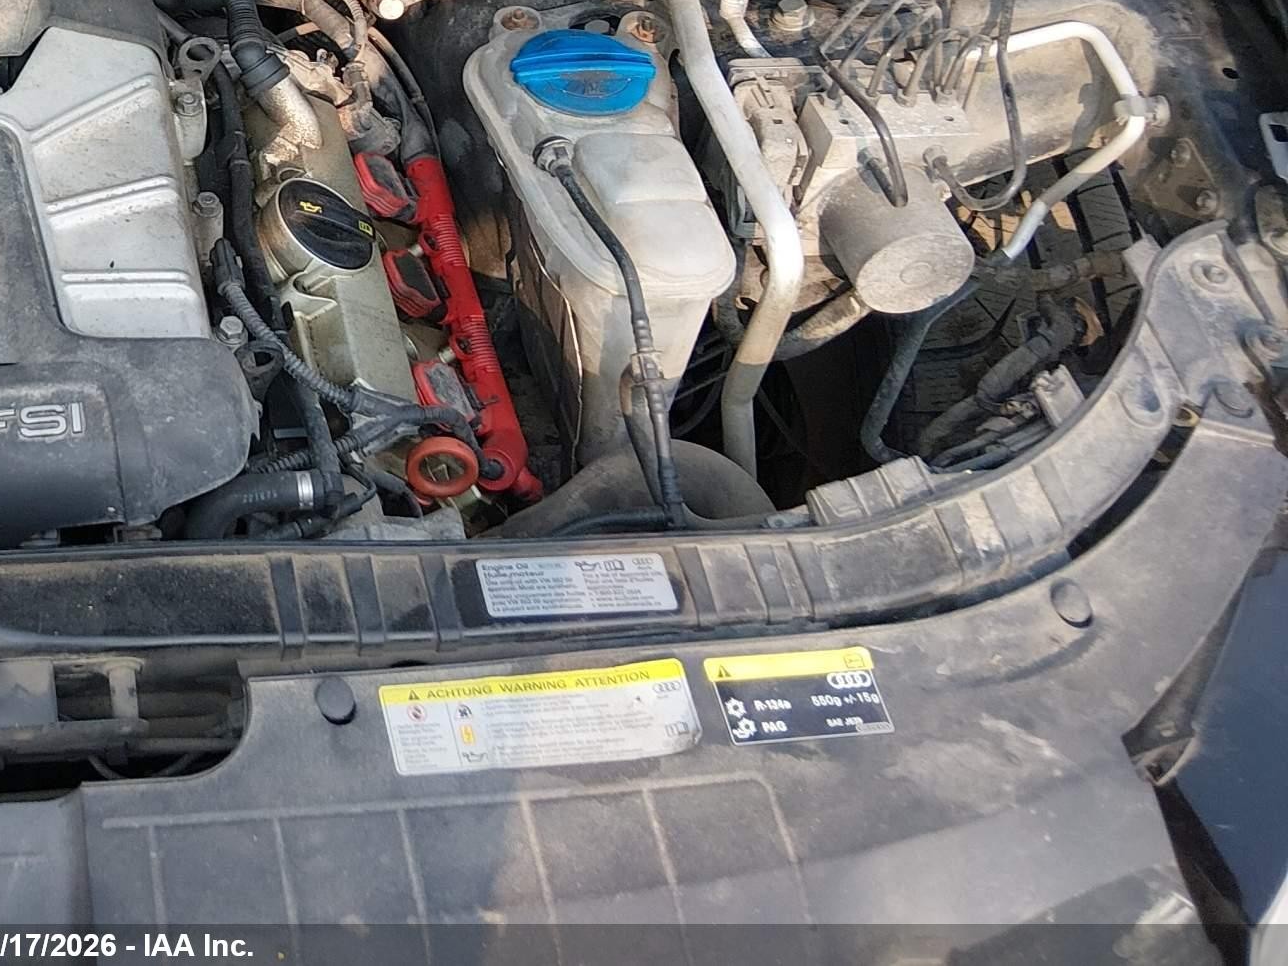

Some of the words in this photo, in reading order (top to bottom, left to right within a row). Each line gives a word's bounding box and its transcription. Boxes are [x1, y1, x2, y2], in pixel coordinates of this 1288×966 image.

[482, 564, 513, 574] Engine
[515, 562, 529, 570] Oil
[427, 684, 493, 700] ACHTUNG
[499, 678, 568, 694] WARNING
[575, 670, 651, 689] ATTENTION
[761, 720, 788, 733] PAG
